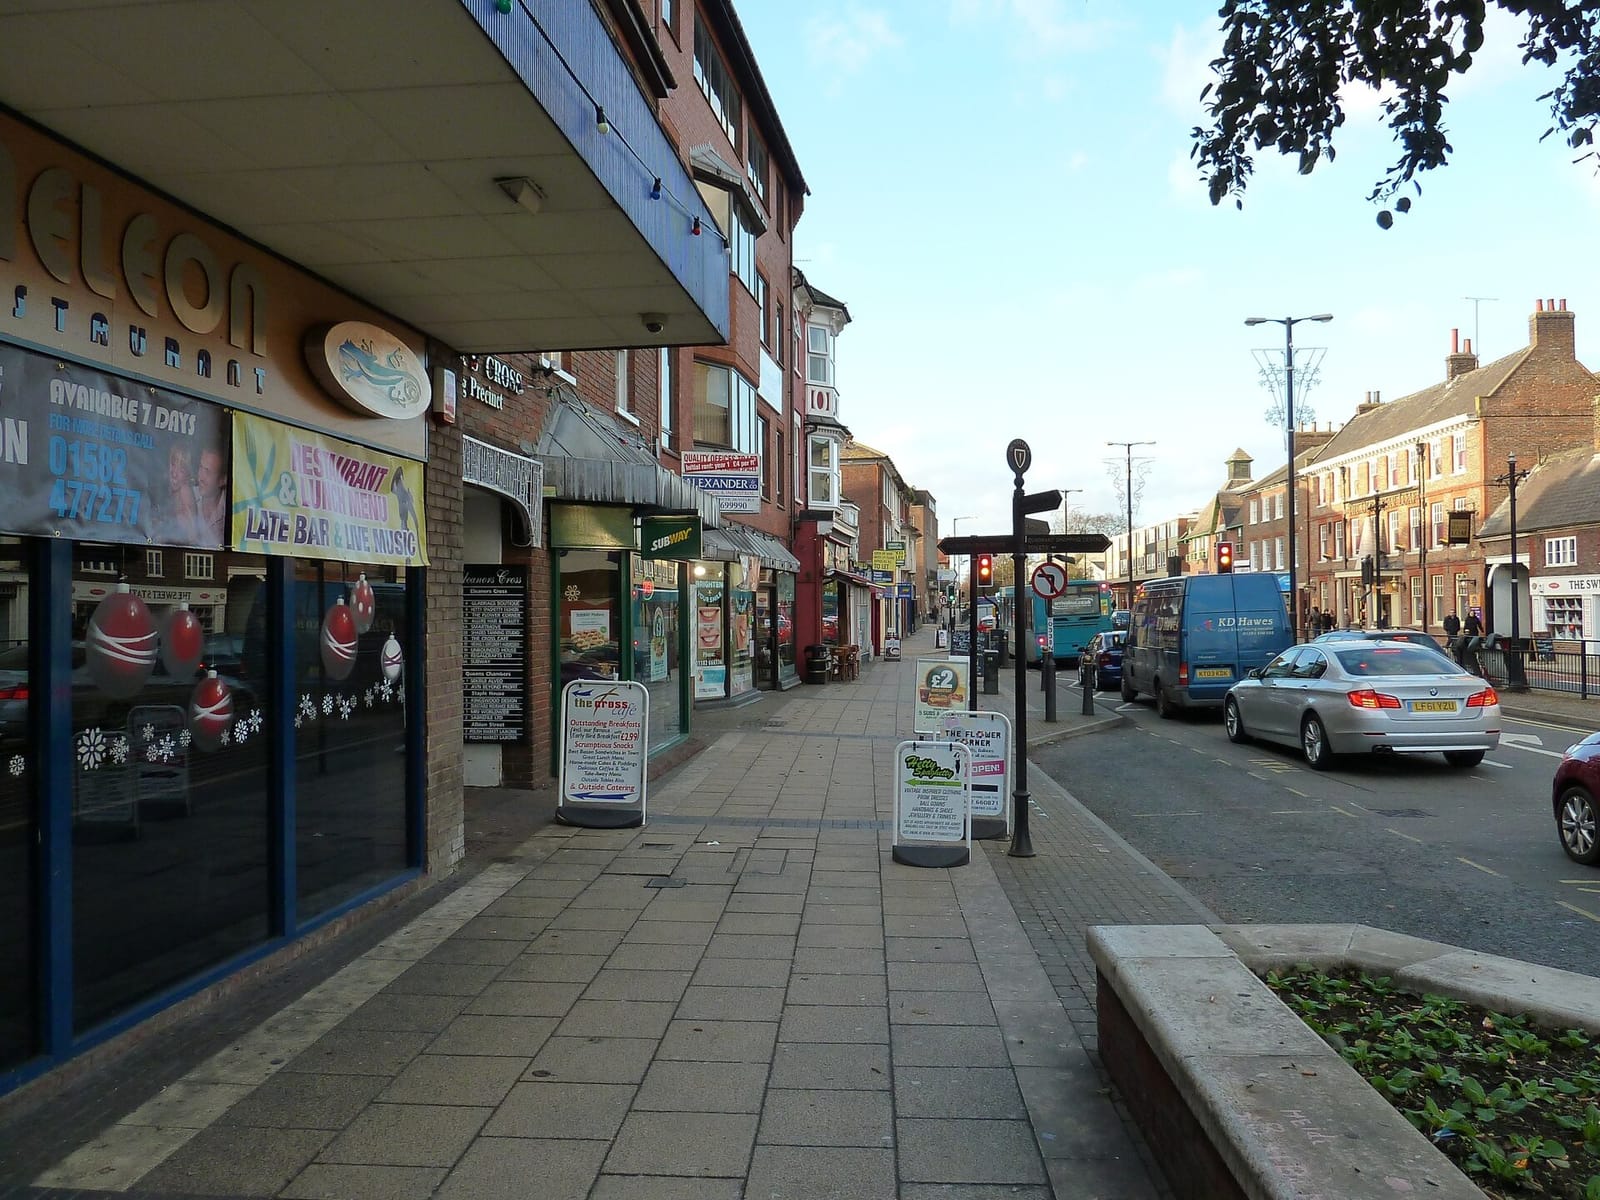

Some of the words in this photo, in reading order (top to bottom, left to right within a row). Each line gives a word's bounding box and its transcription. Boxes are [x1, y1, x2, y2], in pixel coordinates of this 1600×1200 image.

[486, 356, 524, 395] CROSS
[470, 376, 503, 410] Precinct
[50, 378, 139, 423] AVAILABLE
[141, 402, 152, 425] 7
[155, 406, 197, 436] DAYS
[49, 413, 70, 431] FOR
[49, 435, 127, 484] 01582
[49, 479, 141, 526] 477277
[279, 471, 298, 507] &
[350, 490, 389, 523] MENU
[246, 506, 290, 544] LATE
[294, 514, 330, 547] BAR
[334, 521, 343, 549] &
[345, 523, 371, 553] LIVE
[373, 527, 417, 558] MUSIC
[650, 527, 692, 551] SUBWAY
[496, 568, 522, 585] Cross
[1568, 580, 1586, 590] THE
[1218, 618, 1236, 626] KD
[1238, 617, 1273, 626] Hawes
[931, 670, 953, 688] £2
[575, 698, 592, 708] the
[1436, 702, 1454, 710] YZU
[570, 720, 607, 728] Outstanding
[608, 720, 640, 728] Breakfasts
[965, 730, 1001, 739] FLOWER
[575, 741, 612, 750] Scrumptious
[905, 755, 938, 769] Hetty
[606, 784, 635, 792] Catering
